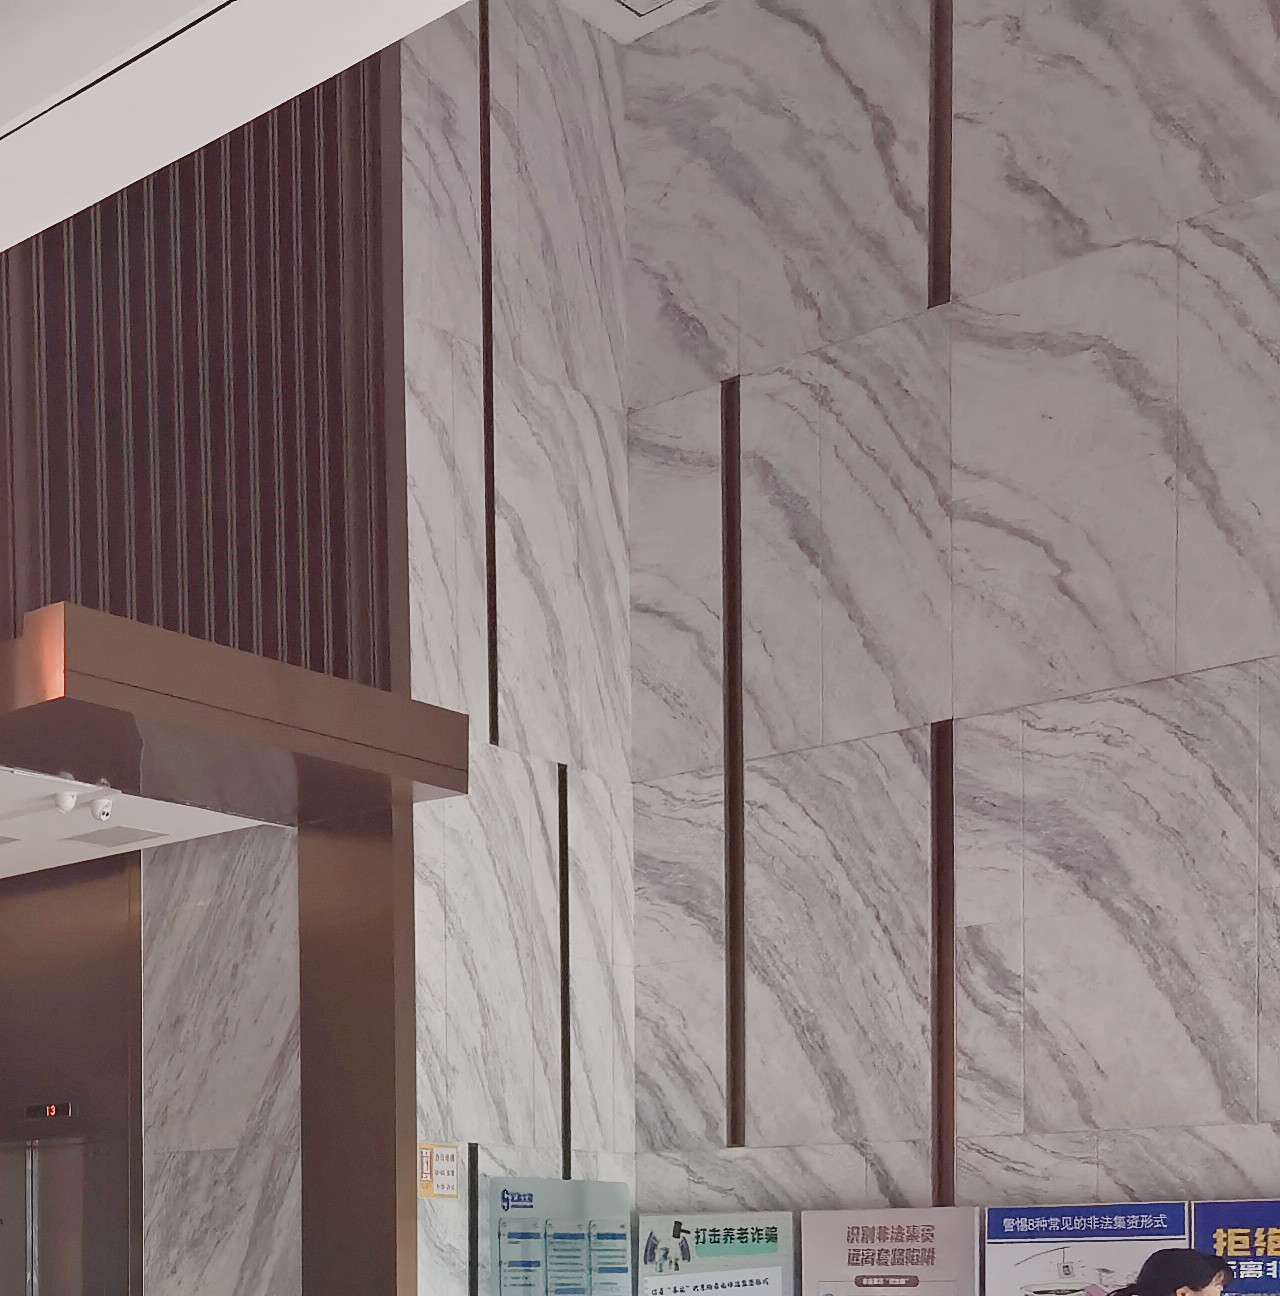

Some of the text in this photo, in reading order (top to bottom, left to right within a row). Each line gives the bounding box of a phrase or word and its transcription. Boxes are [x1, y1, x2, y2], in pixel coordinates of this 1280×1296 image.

[1003, 1213, 1168, 1233] 警惕8种常见的非法集资形式
[694, 1226, 779, 1246] 打击养老诈骗
[846, 1224, 936, 1244] 识别非法集资
[1213, 1228, 1280, 1257] 拒绝
[847, 1247, 937, 1267] 远离套路陷阱
